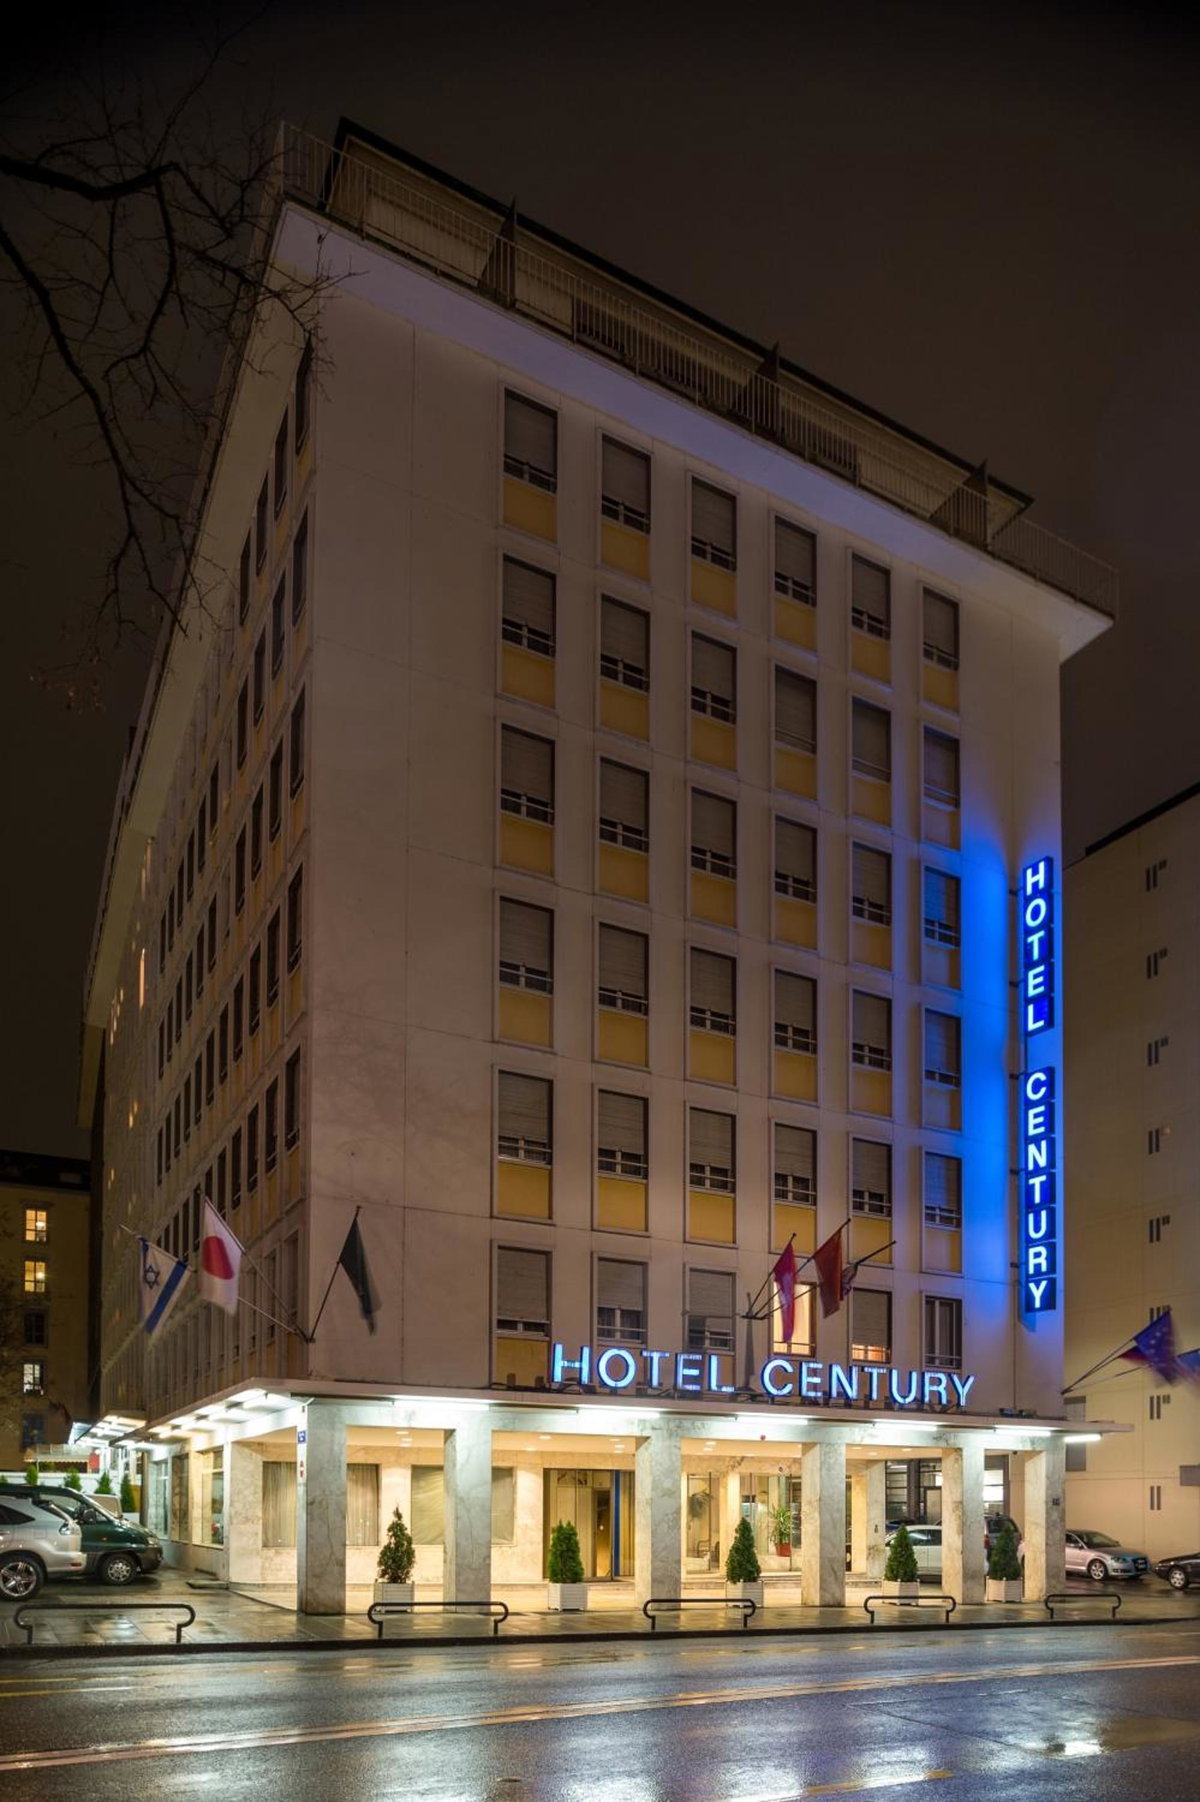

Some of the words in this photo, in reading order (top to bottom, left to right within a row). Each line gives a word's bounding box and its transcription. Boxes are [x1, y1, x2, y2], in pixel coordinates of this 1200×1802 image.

[1024, 861, 1047, 1030] HOTEL
[1026, 1072, 1048, 1309] CENTURY
[551, 1343, 735, 1393] HOTEL
[761, 1358, 976, 1407] CENTURY
